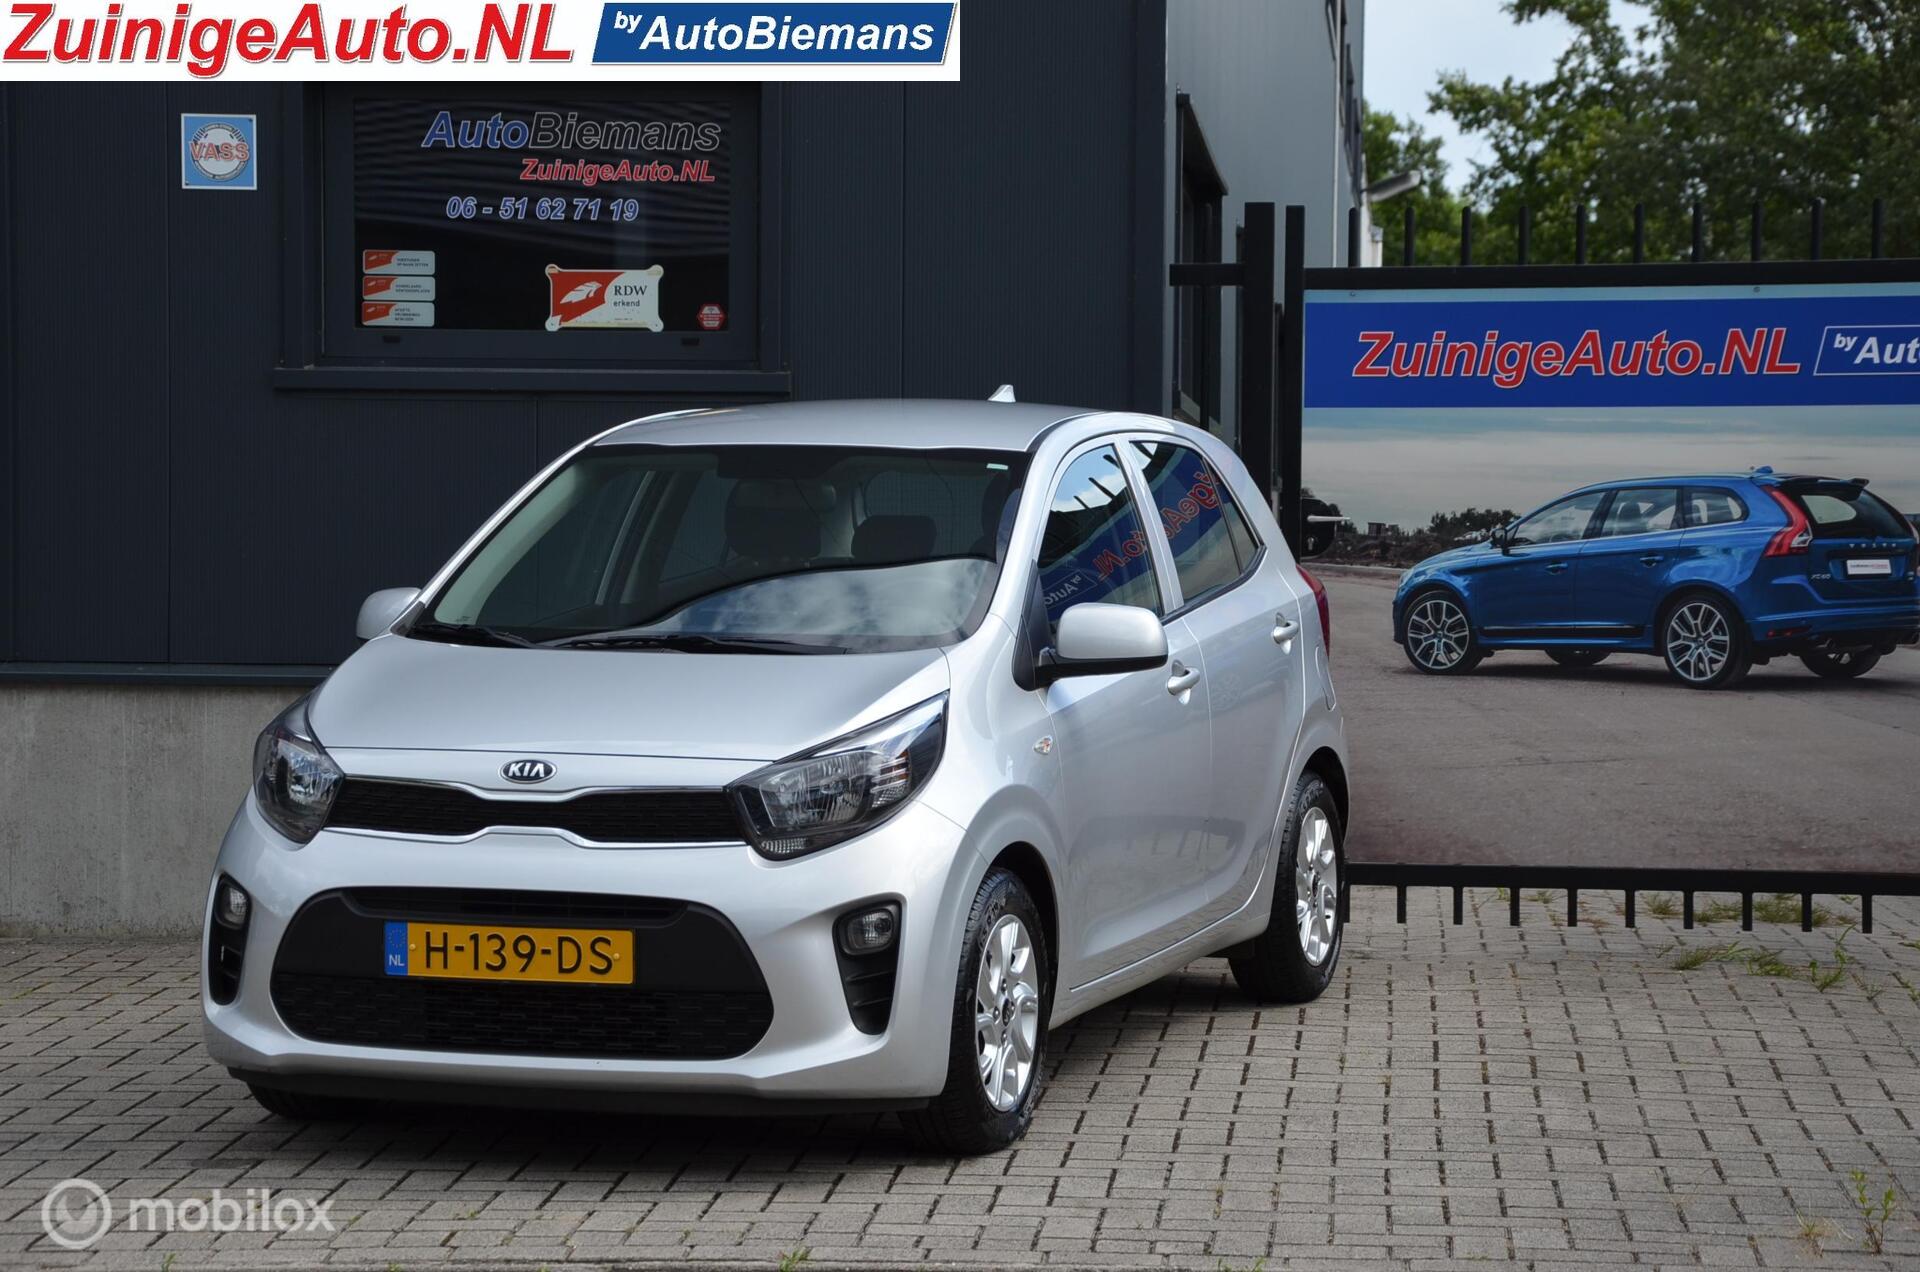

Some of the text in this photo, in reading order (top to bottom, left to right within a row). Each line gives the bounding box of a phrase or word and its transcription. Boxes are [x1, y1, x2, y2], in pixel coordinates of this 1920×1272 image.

[421, 111, 721, 151] AutoBiemans
[188, 141, 250, 162] VASS
[520, 158, 715, 187] ZuinigeAuto.NL
[446, 196, 477, 219] 06
[499, 197, 528, 220] 51
[535, 198, 567, 220] 62
[572, 198, 602, 221] 71
[609, 199, 640, 222] 19
[612, 299, 641, 308] erkend
[613, 284, 648, 297] RDW
[1351, 326, 1801, 389] ZuinigeAuto.NL
[1833, 332, 1920, 365] by Aut
[508, 762, 545, 777] KIA
[389, 954, 405, 967] NL
[425, 930, 613, 976] H-139-DS
